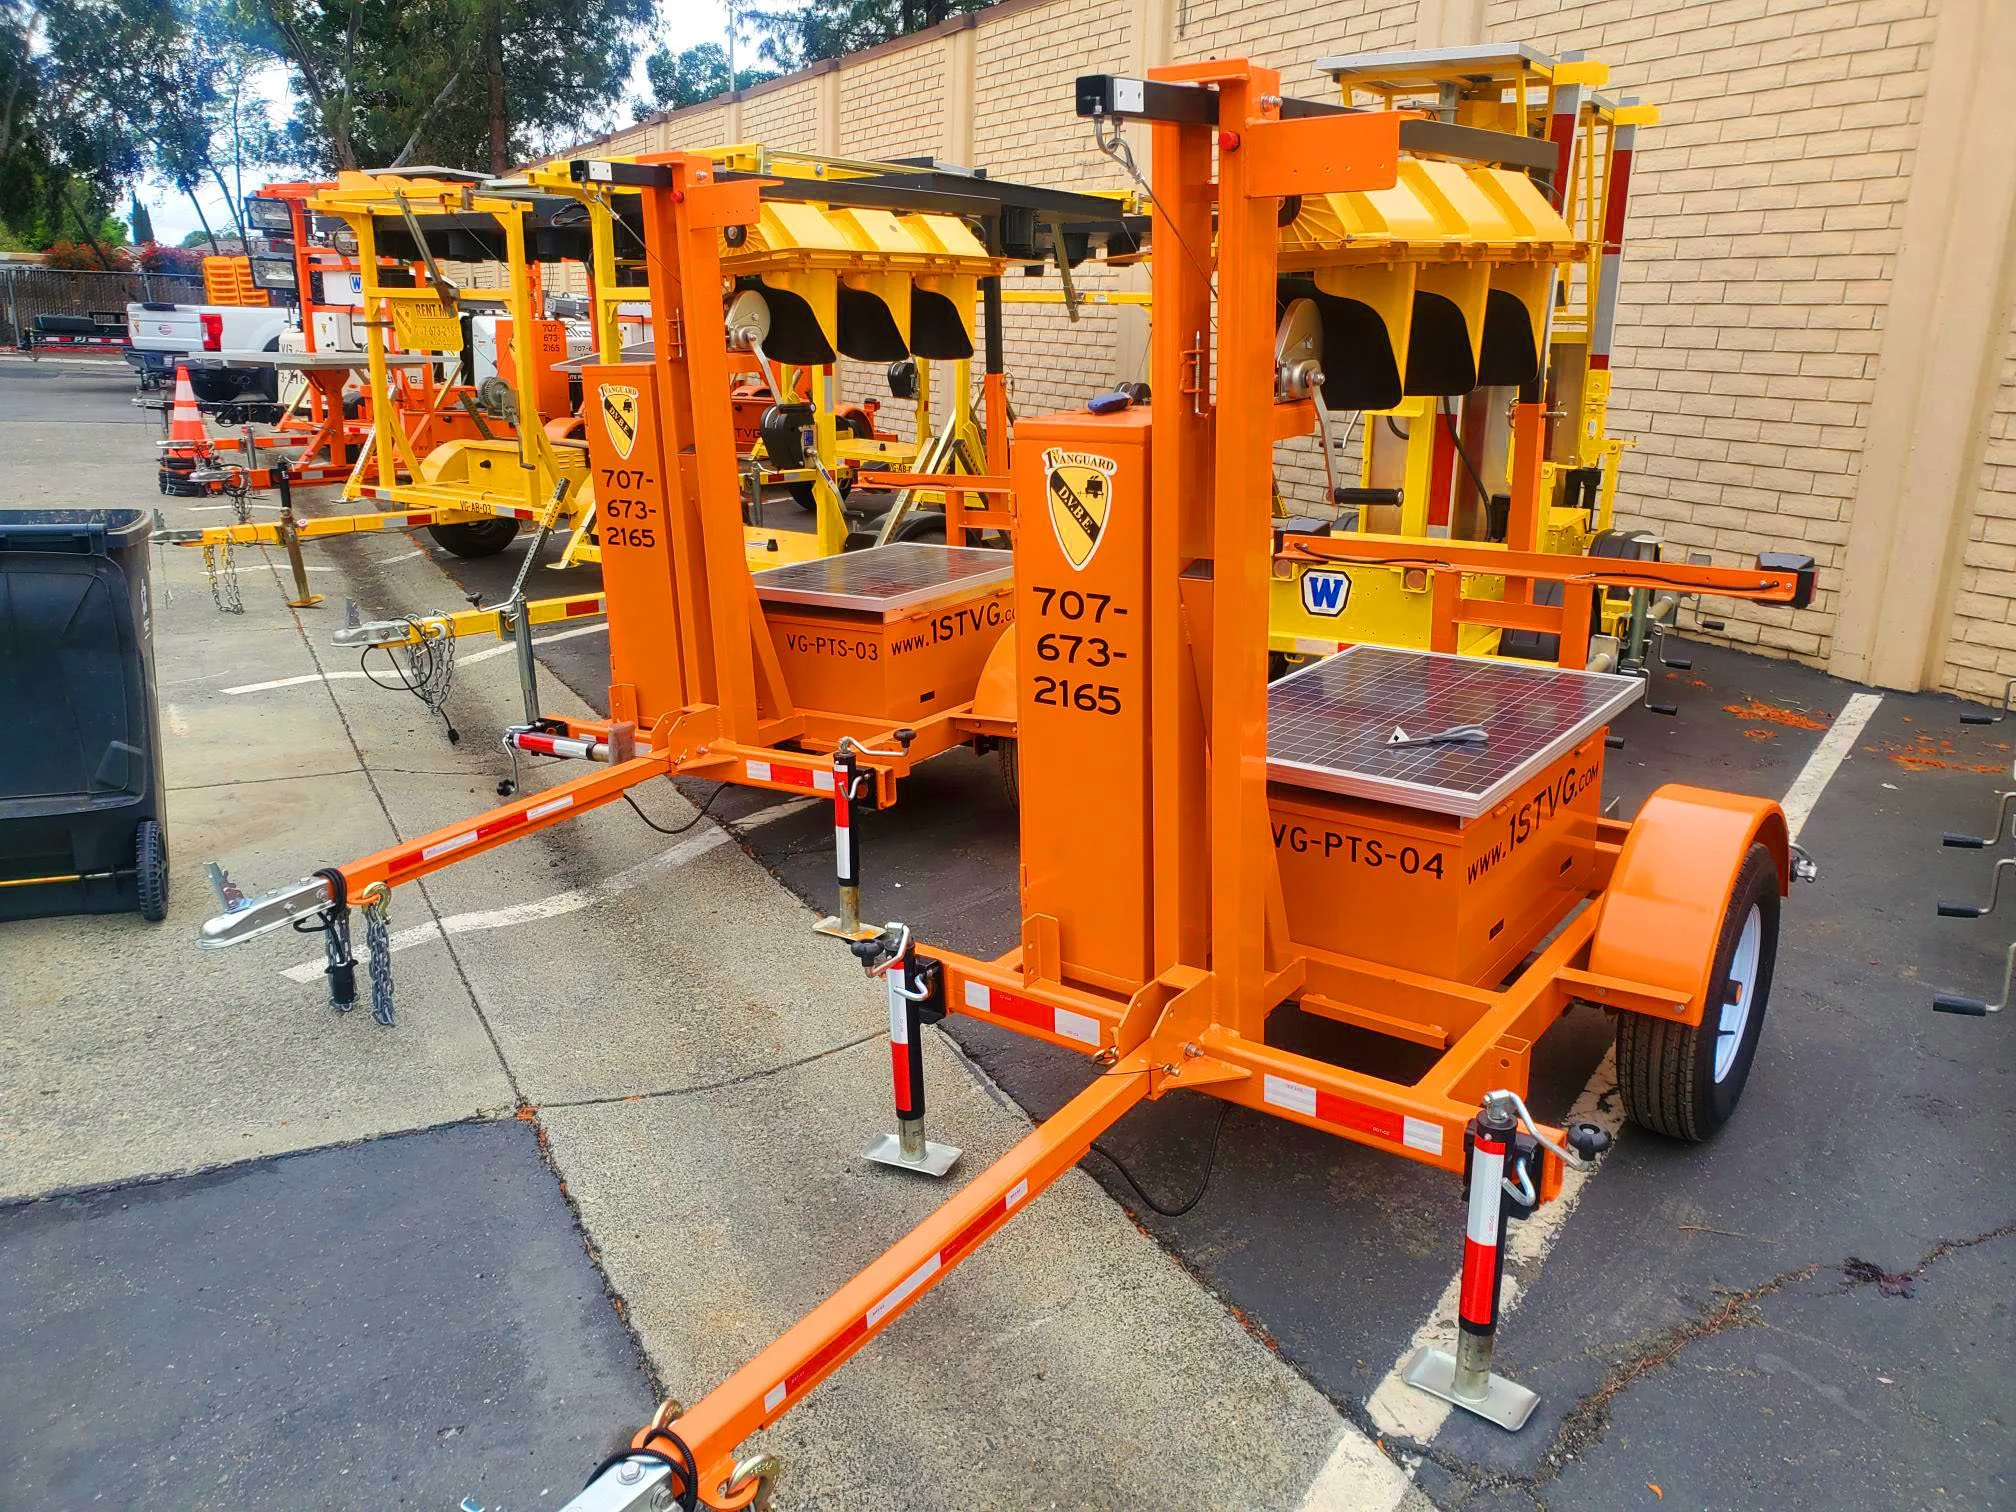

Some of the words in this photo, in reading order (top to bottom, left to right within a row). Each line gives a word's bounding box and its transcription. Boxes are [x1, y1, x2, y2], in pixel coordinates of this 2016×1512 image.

[415, 304, 436, 317] RENT
[543, 344, 560, 352] 2165
[1053, 454, 1115, 471] VANGUARD
[601, 469, 654, 490] 707-
[460, 500, 492, 515] VG-AB-03
[607, 500, 657, 520] 673-
[1058, 485, 1095, 534] D.V.B.E.
[605, 527, 656, 549] 2165
[1032, 586, 1129, 623] 707-
[1309, 576, 1344, 609] W
[786, 633, 879, 661] VG-PTS-03
[1036, 633, 1128, 668] 673-
[1033, 675, 1122, 716] 2165
[1270, 822, 1444, 880] VG-PTS-04
